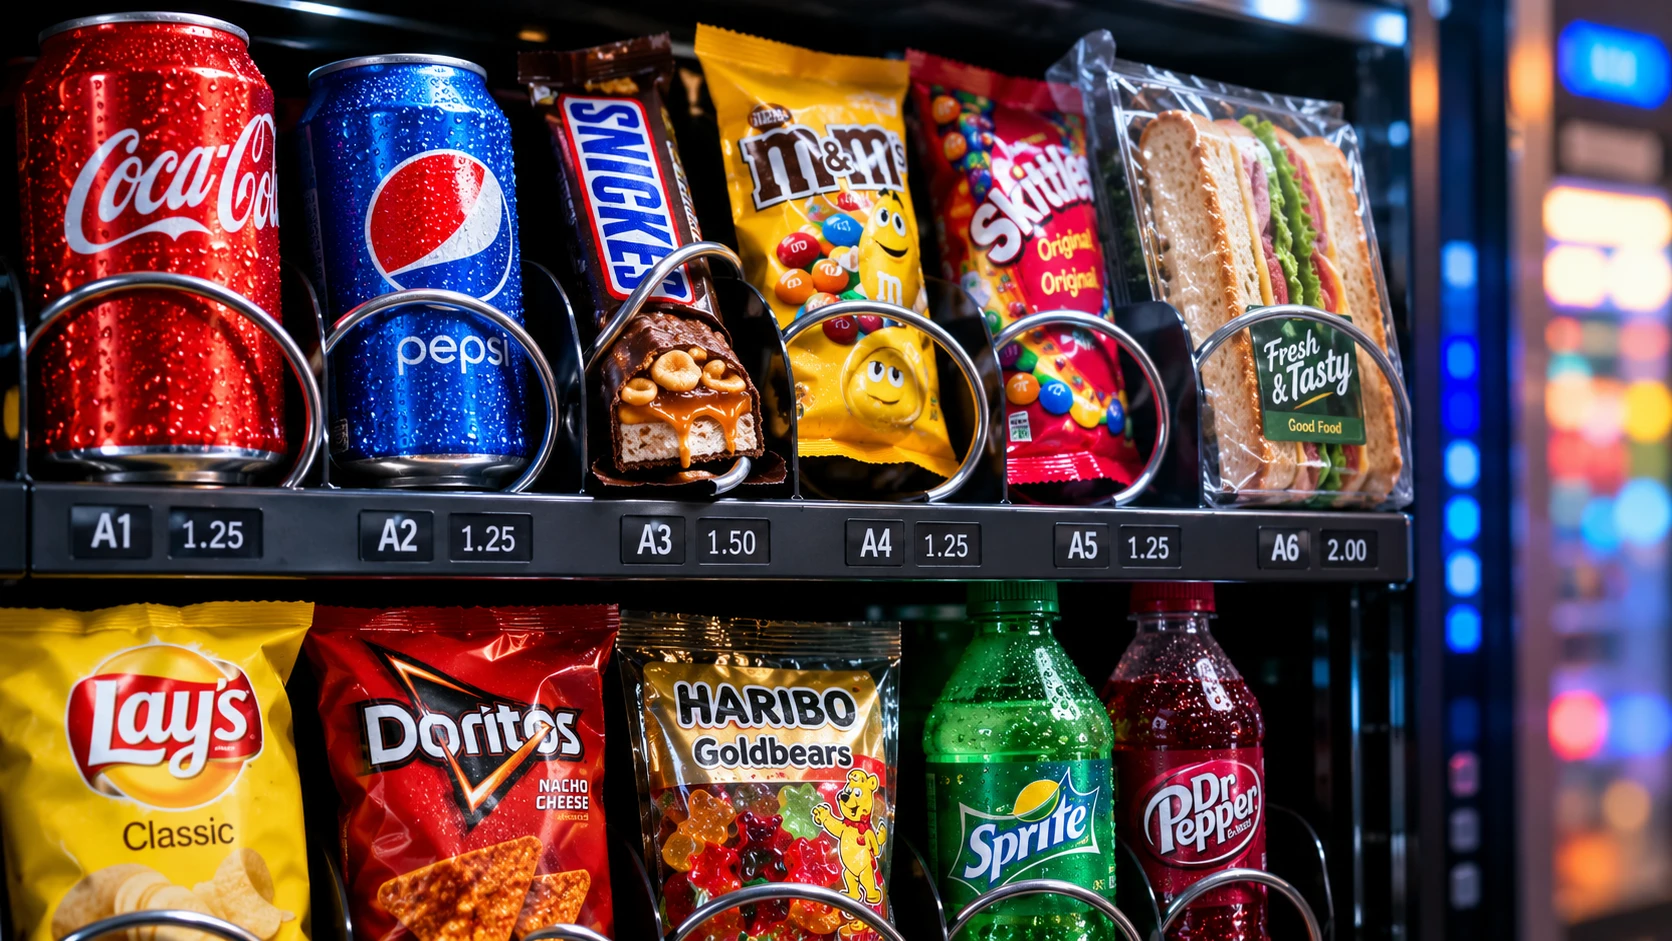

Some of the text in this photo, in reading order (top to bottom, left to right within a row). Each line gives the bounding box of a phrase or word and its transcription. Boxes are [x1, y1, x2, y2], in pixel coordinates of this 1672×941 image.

[63, 113, 279, 254] Coca-Col
[1037, 228, 1095, 261] Original
[1041, 267, 1100, 297] Original
[397, 332, 510, 376] pepsi
[1263, 328, 1320, 372] Fresh
[1272, 349, 1352, 405] & Tasty
[1288, 418, 1342, 434] Good Food
[90, 512, 244, 549] A1 1.25
[377, 518, 516, 552] A2 1.25
[636, 523, 756, 555] A3 1.50
[860, 527, 968, 558] A4 1.25
[1067, 531, 1169, 559] A5 1.25
[1271, 533, 1367, 561] A6 2.00
[675, 682, 857, 730] HARIBO
[88, 678, 248, 779] Lay's
[363, 703, 582, 766] Doritos
[693, 735, 852, 768] Goldbears
[536, 795, 589, 810] CHEESE
[539, 779, 589, 793] NACHO
[1190, 772, 1236, 814] Dr
[122, 816, 235, 851] Classic
[963, 794, 1087, 884] Sprite
